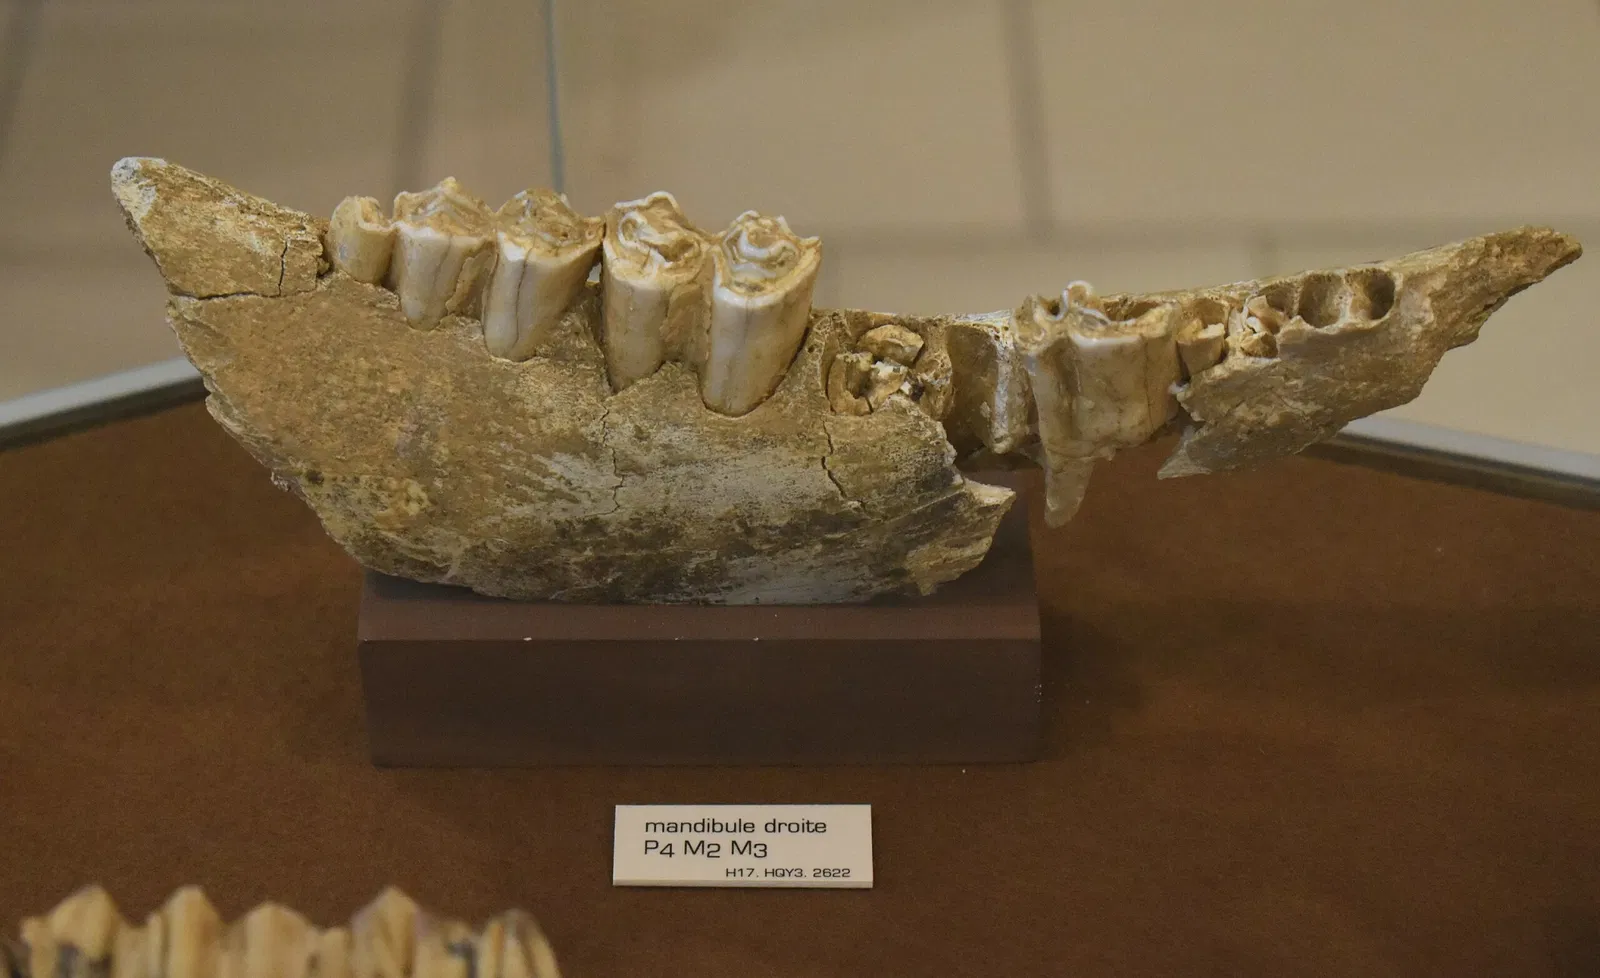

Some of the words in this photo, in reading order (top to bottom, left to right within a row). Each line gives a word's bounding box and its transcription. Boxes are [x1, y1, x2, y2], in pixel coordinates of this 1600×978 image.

[645, 818, 756, 833] mandibule
[764, 818, 827, 833] droite
[644, 840, 675, 858] P4
[683, 840, 721, 858] M2
[731, 840, 768, 858] M3
[725, 868, 759, 878] H17.
[812, 868, 851, 878] 2622
